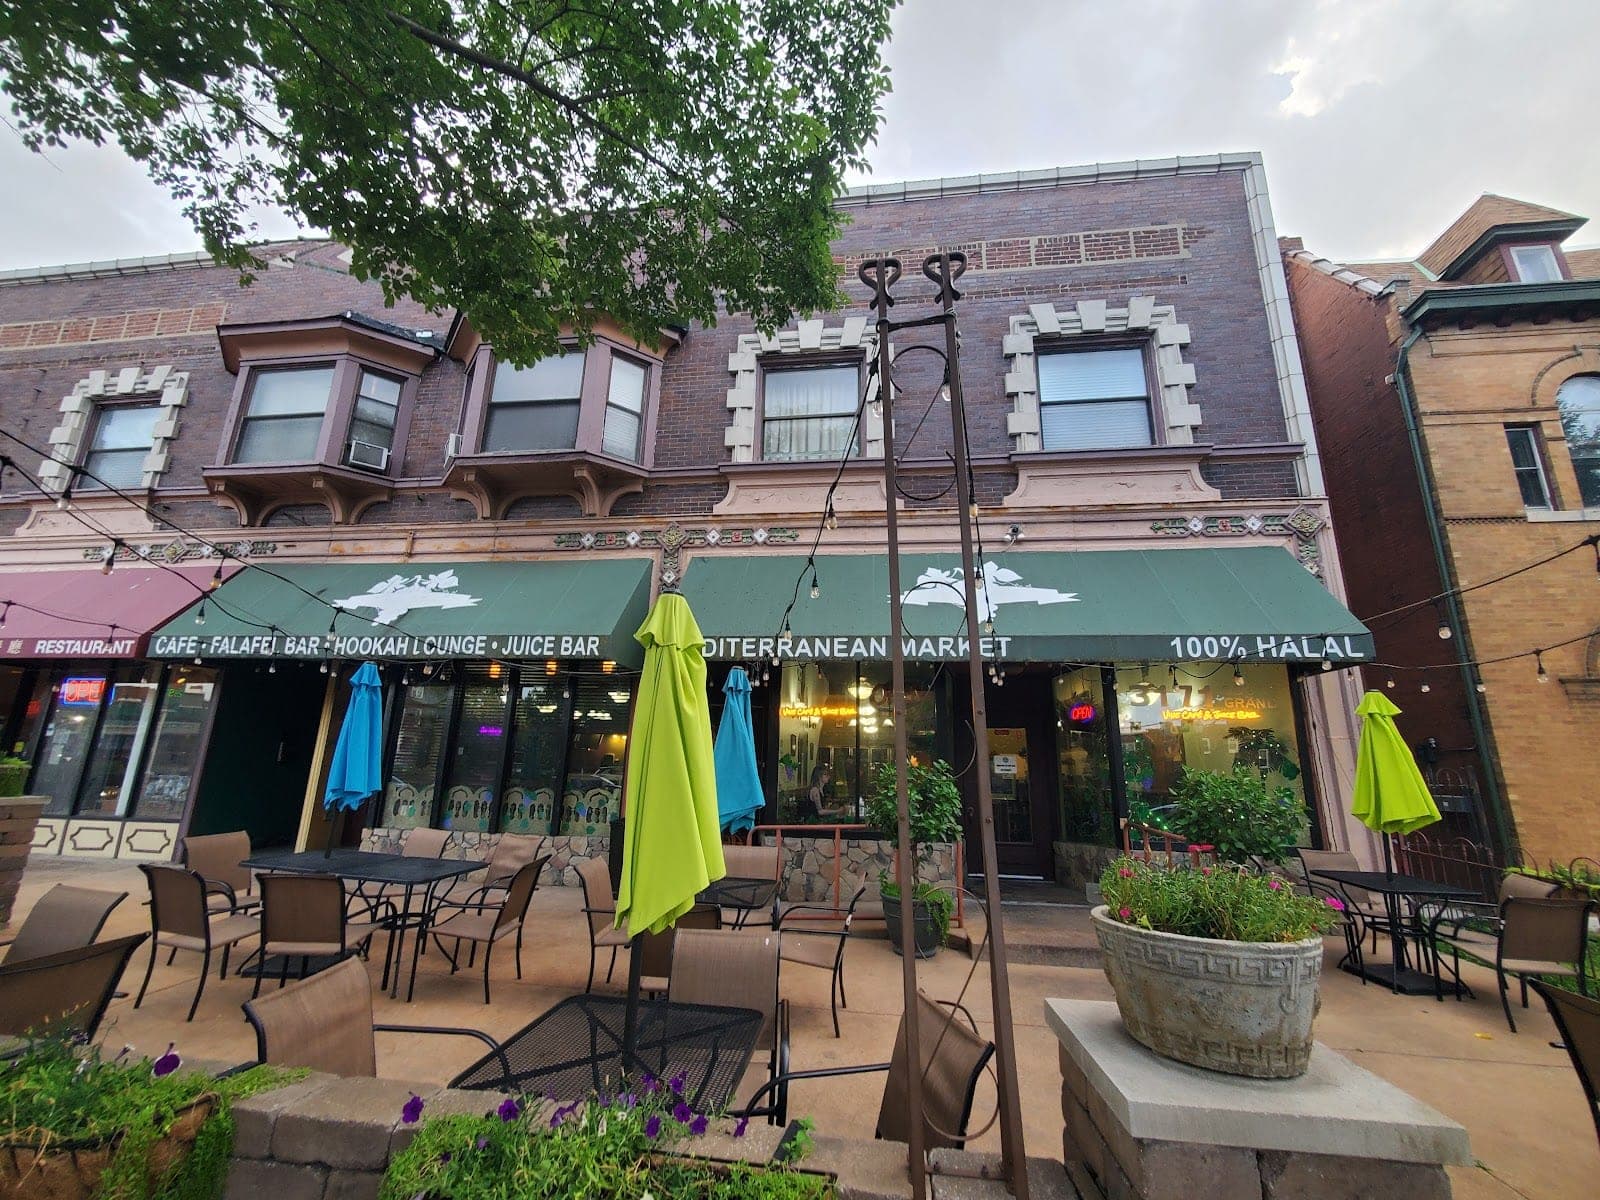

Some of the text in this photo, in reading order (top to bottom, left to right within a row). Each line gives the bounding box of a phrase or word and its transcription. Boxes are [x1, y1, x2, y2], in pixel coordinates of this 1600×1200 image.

[34, 640, 135, 655] RESTAURANT
[155, 635, 600, 656] CAFE FALAFEL BAR HOOKAH LOUNGE JUICE BAR
[701, 636, 1012, 658] DITERRANEAN MARKET
[1170, 636, 1365, 658] 100% HALAL
[66, 680, 105, 701] OPE
[1072, 705, 1092, 720] OPEN
